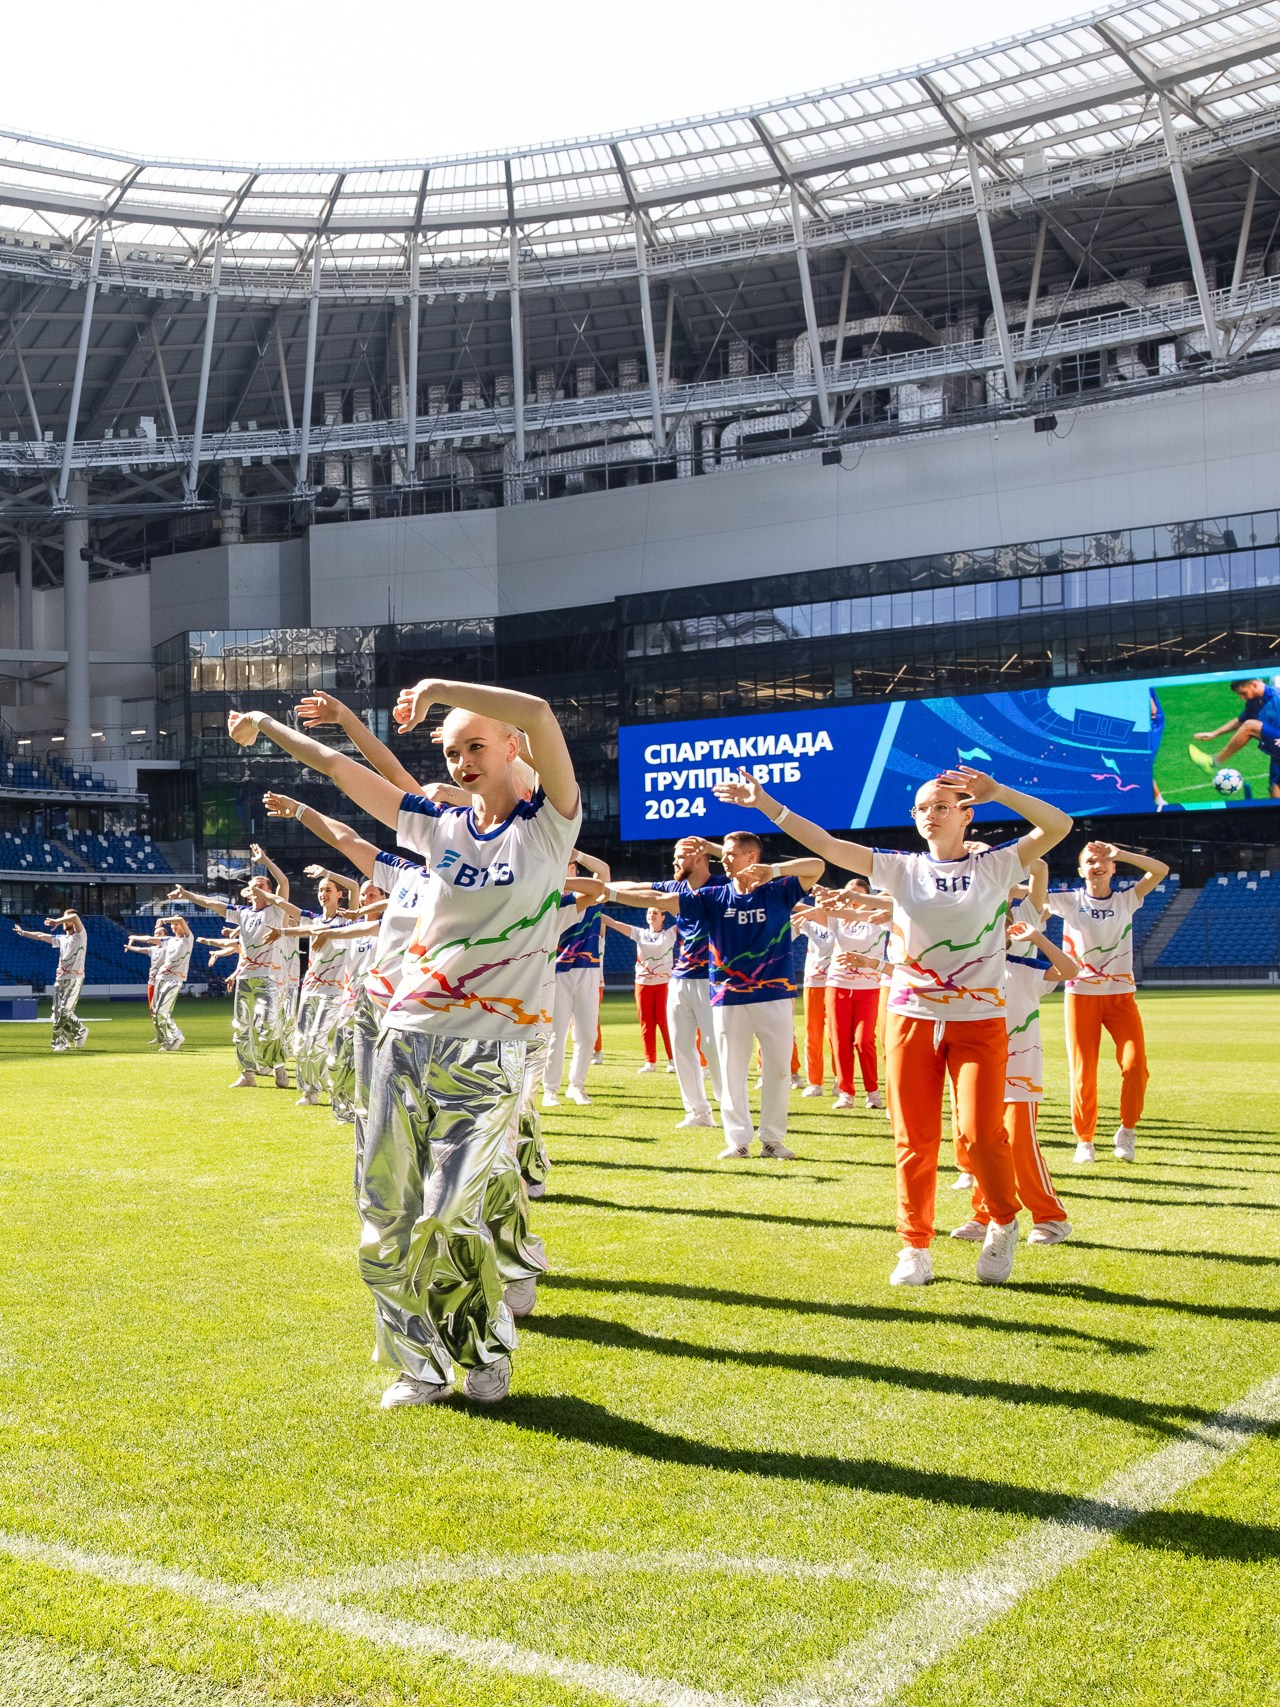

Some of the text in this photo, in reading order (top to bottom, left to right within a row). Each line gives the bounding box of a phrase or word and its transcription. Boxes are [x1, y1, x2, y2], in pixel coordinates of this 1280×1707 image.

[644, 730, 834, 765] СПАРТАКИАДА
[644, 761, 802, 792] ГРУППЫ ВТБ
[645, 797, 707, 820] 2024
[737, 908, 767, 925] ВТБ
